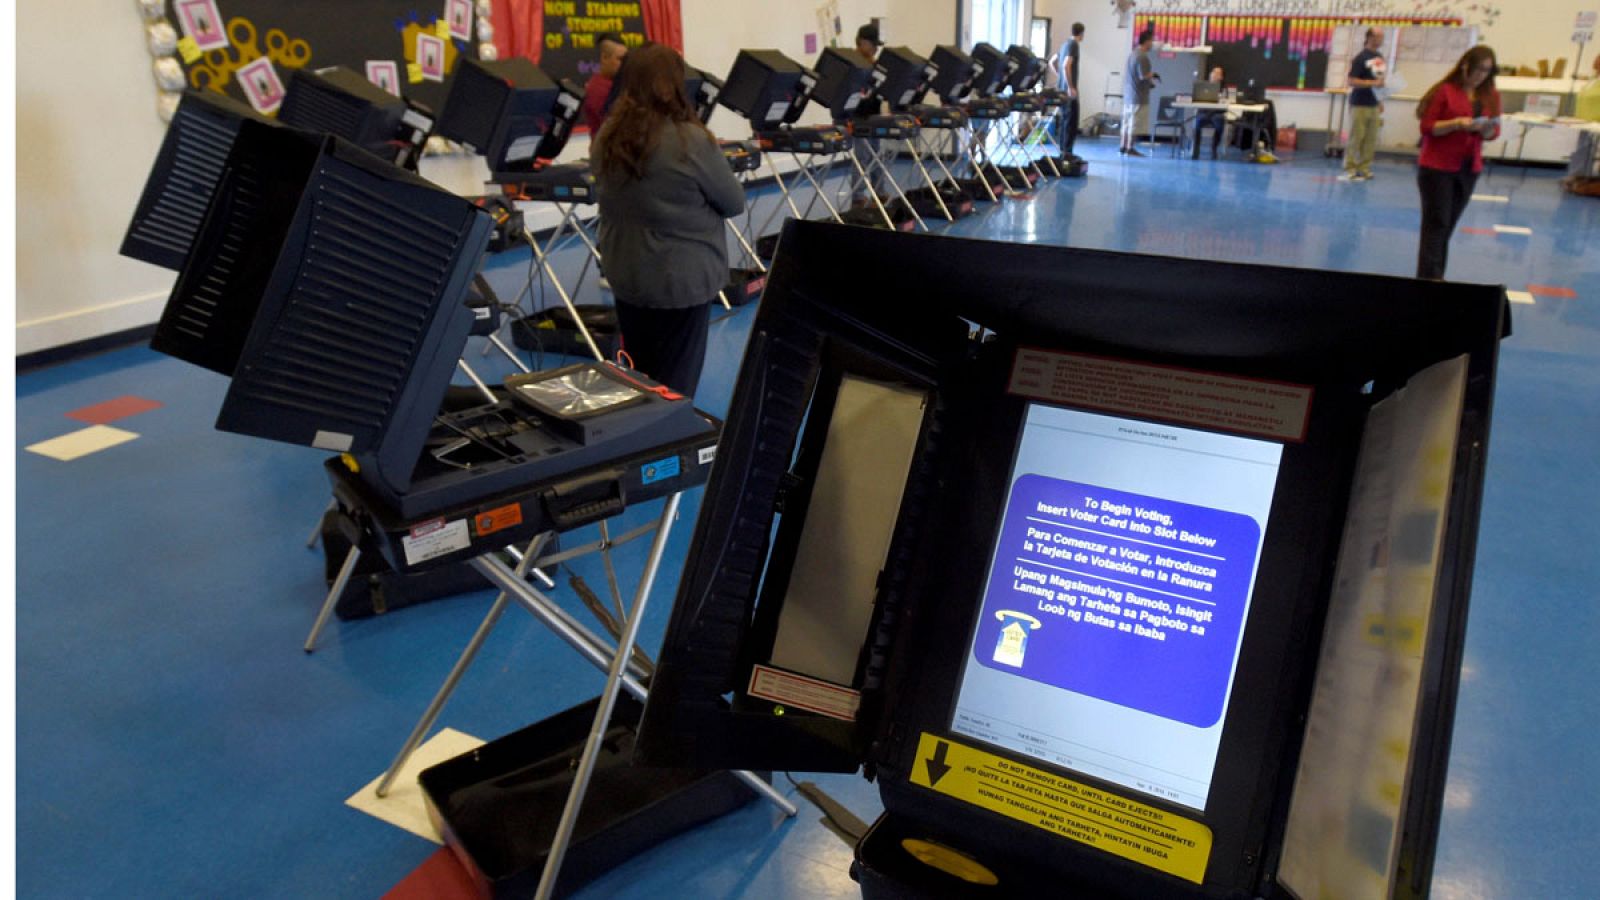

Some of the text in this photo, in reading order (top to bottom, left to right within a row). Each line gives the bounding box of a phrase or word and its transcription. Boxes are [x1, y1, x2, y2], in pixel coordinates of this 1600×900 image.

[545, 33, 563, 48] OF
[570, 33, 595, 48] THE
[566, 17, 623, 31] STUDENTS
[1037, 502, 1068, 517] Insert
[1070, 509, 1098, 523] Voter
[1101, 516, 1127, 529] Card
[1154, 526, 1178, 540] Slot
[1180, 531, 1217, 548] Below
[1084, 497, 1173, 526] To Begin Voting,
[1024, 540, 1212, 592] la Tarjeta de Votación en la Ranura
[1028, 528, 1217, 578] Para Comenzar a Votar, Introduzca
[1014, 566, 1212, 623] Upang Magsimula'ng Bumoto, Isingit
[1014, 581, 1204, 636] Lamang ang Tarheta sa Pagboto sa
[1038, 601, 1166, 641] Loob ng Butas sa Ibaba
[977, 769, 1000, 782] QUITE
[1012, 780, 1042, 798] TARJETA
[1043, 791, 1069, 806] HASTA
[1071, 799, 1088, 812] QUE
[1088, 804, 1113, 820] SALGA
[1009, 764, 1025, 774] NOT
[1026, 769, 1056, 784] REMOVE
[1081, 788, 1103, 801] UNTIL
[1105, 794, 1127, 809] CARD
[978, 788, 1004, 802] HUWAG
[1006, 795, 1047, 818] TANGGALIN
[1049, 814, 1065, 824] ANG
[1105, 831, 1141, 852] HINTAYIN
[1040, 819, 1055, 830] ANG
